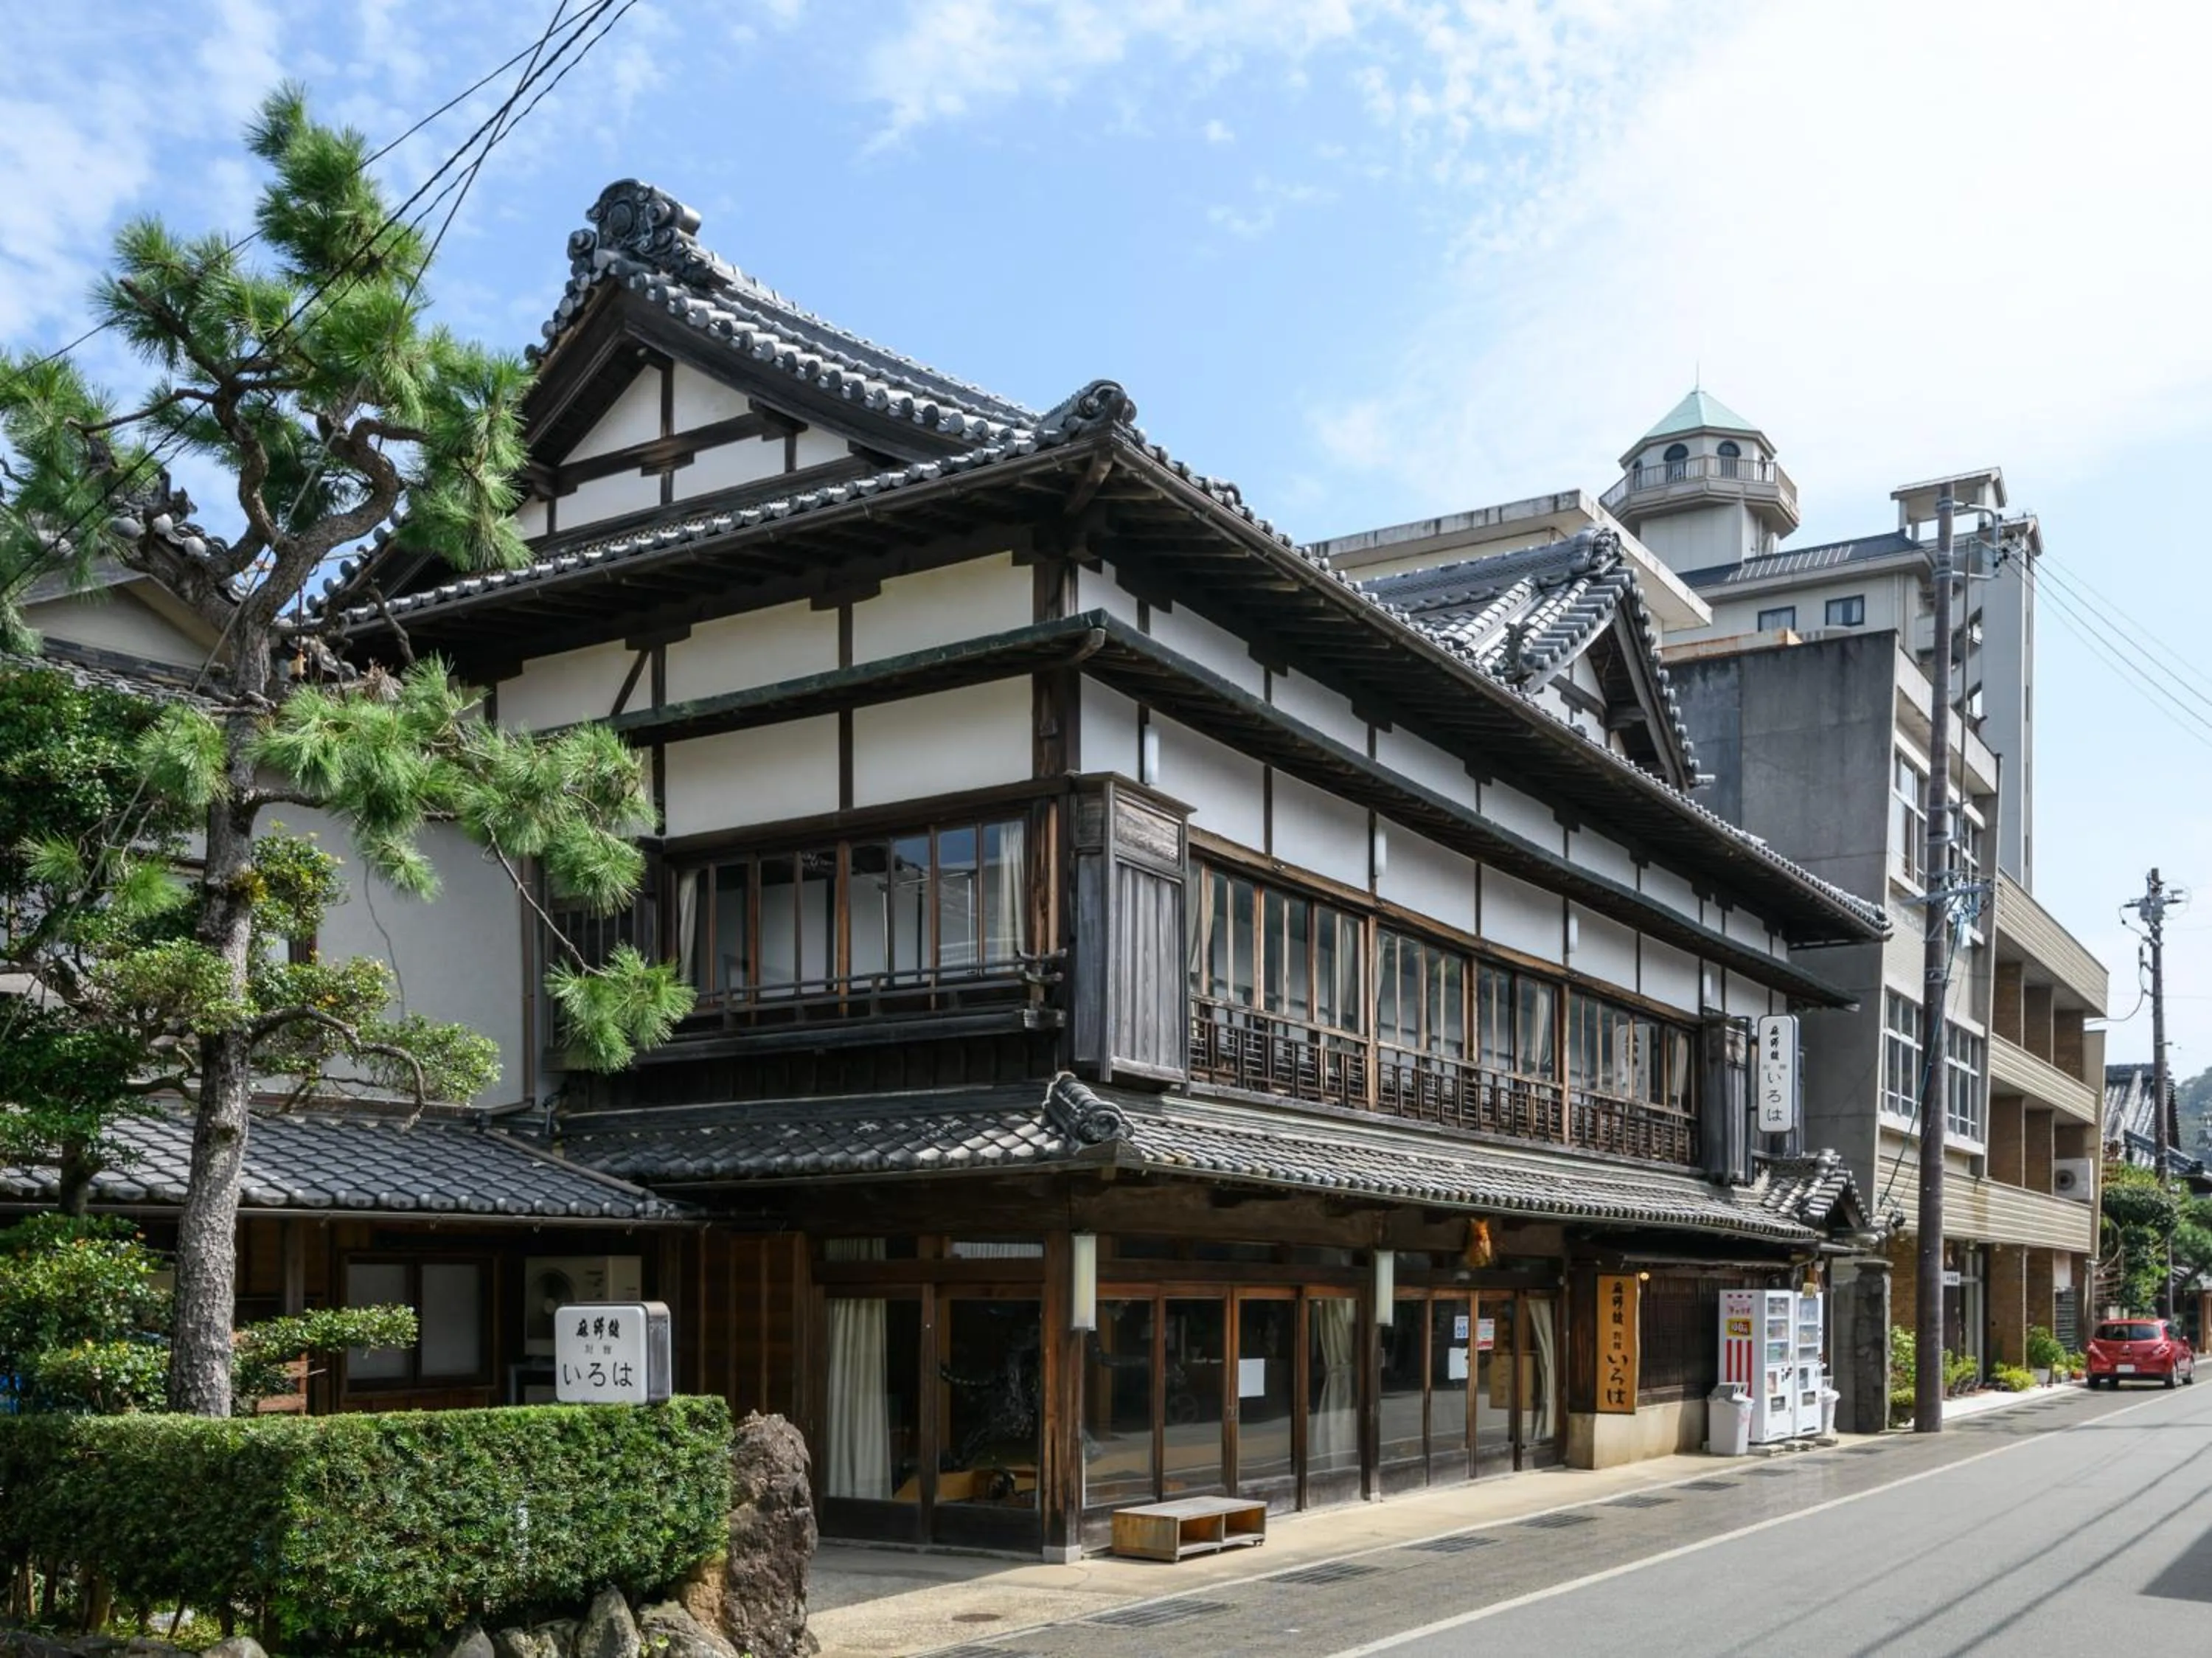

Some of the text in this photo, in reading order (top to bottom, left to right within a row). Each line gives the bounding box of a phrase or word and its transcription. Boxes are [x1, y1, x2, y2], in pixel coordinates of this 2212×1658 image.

[1767, 1072, 1782, 1122] いろは
[563, 1362, 633, 1387] いろは
[1607, 1354, 1628, 1405] いろは
